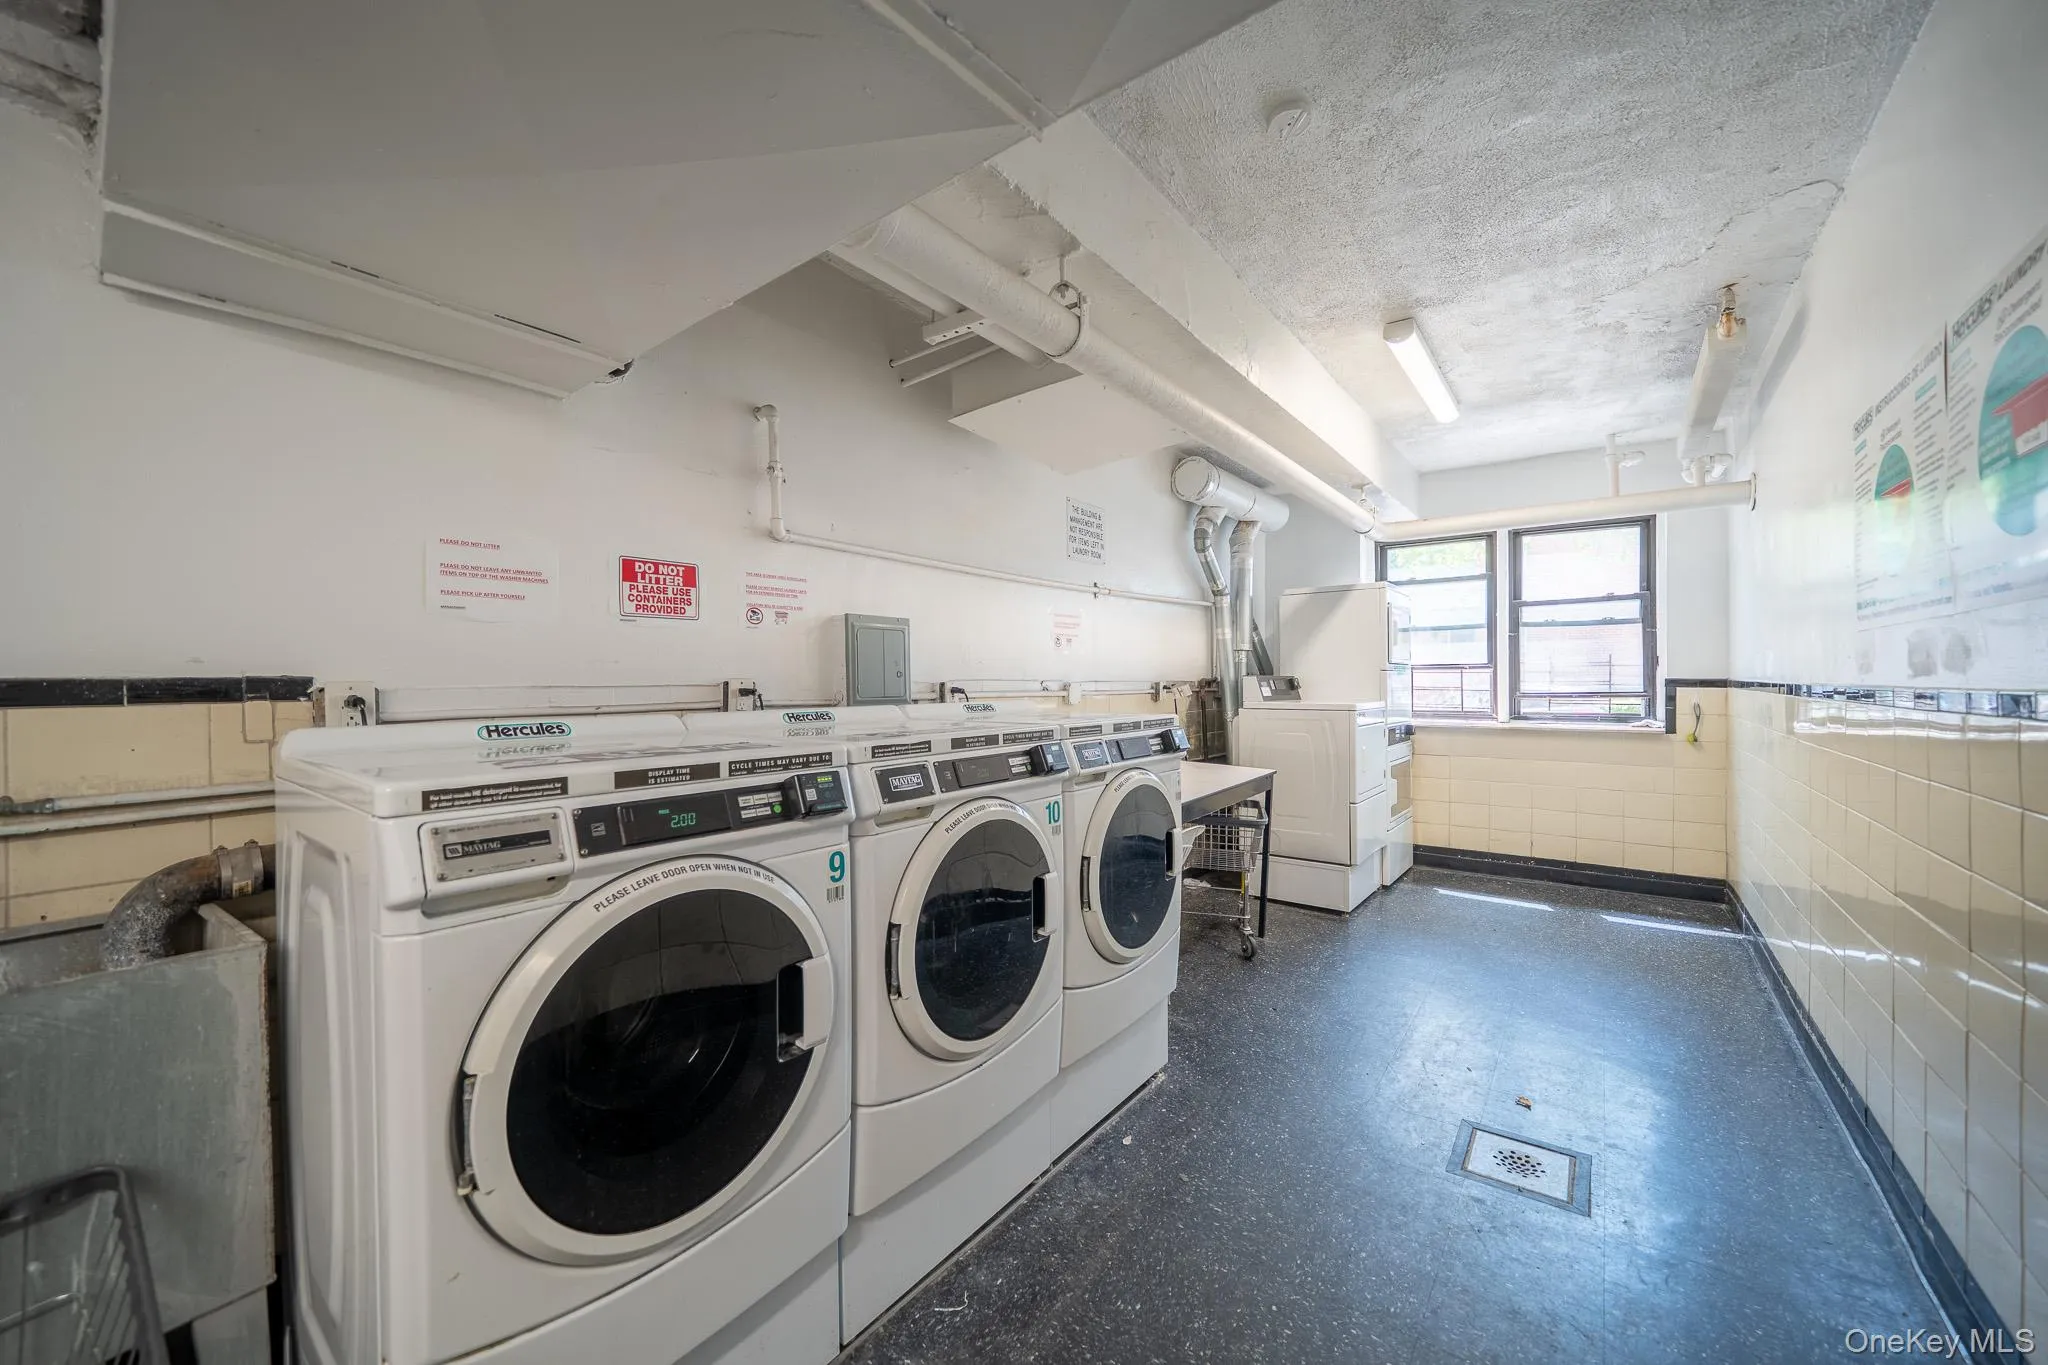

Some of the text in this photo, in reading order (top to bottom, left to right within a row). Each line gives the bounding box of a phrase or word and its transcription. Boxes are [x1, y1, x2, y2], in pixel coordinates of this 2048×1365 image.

[1072, 505, 1080, 515] THE
[1081, 508, 1098, 520] BUILDING
[1070, 516, 1094, 528] MANAGEMENT
[1070, 525, 1103, 540] NOT RESPONSIBLE
[1068, 534, 1076, 543] FOR
[1078, 538, 1089, 547] ITEMS
[1072, 547, 1089, 557] LAUNDRY
[635, 562, 684, 577] DO NOT
[638, 573, 683, 586] LITTER
[629, 584, 691, 597] PLEASE USE
[628, 594, 692, 606] CONTAINERS
[635, 604, 686, 615] PROVIDED
[786, 712, 832, 722] Hercules
[486, 723, 565, 738] Hercules
[731, 761, 752, 770] CYCLE
[657, 775, 690, 783] ESTIMATED
[891, 776, 921, 786] MAYTAG
[482, 787, 512, 796] detergent
[1045, 801, 1060, 824] 10
[671, 813, 696, 828] 2.00
[944, 817, 962, 834] PLEASE
[961, 810, 975, 820] LEAVE
[463, 841, 501, 852] MAYTAG
[829, 851, 845, 883] 9
[593, 863, 775, 912] PLEASE LEAVE DOOR OPEN WHEN NOT IN USE
